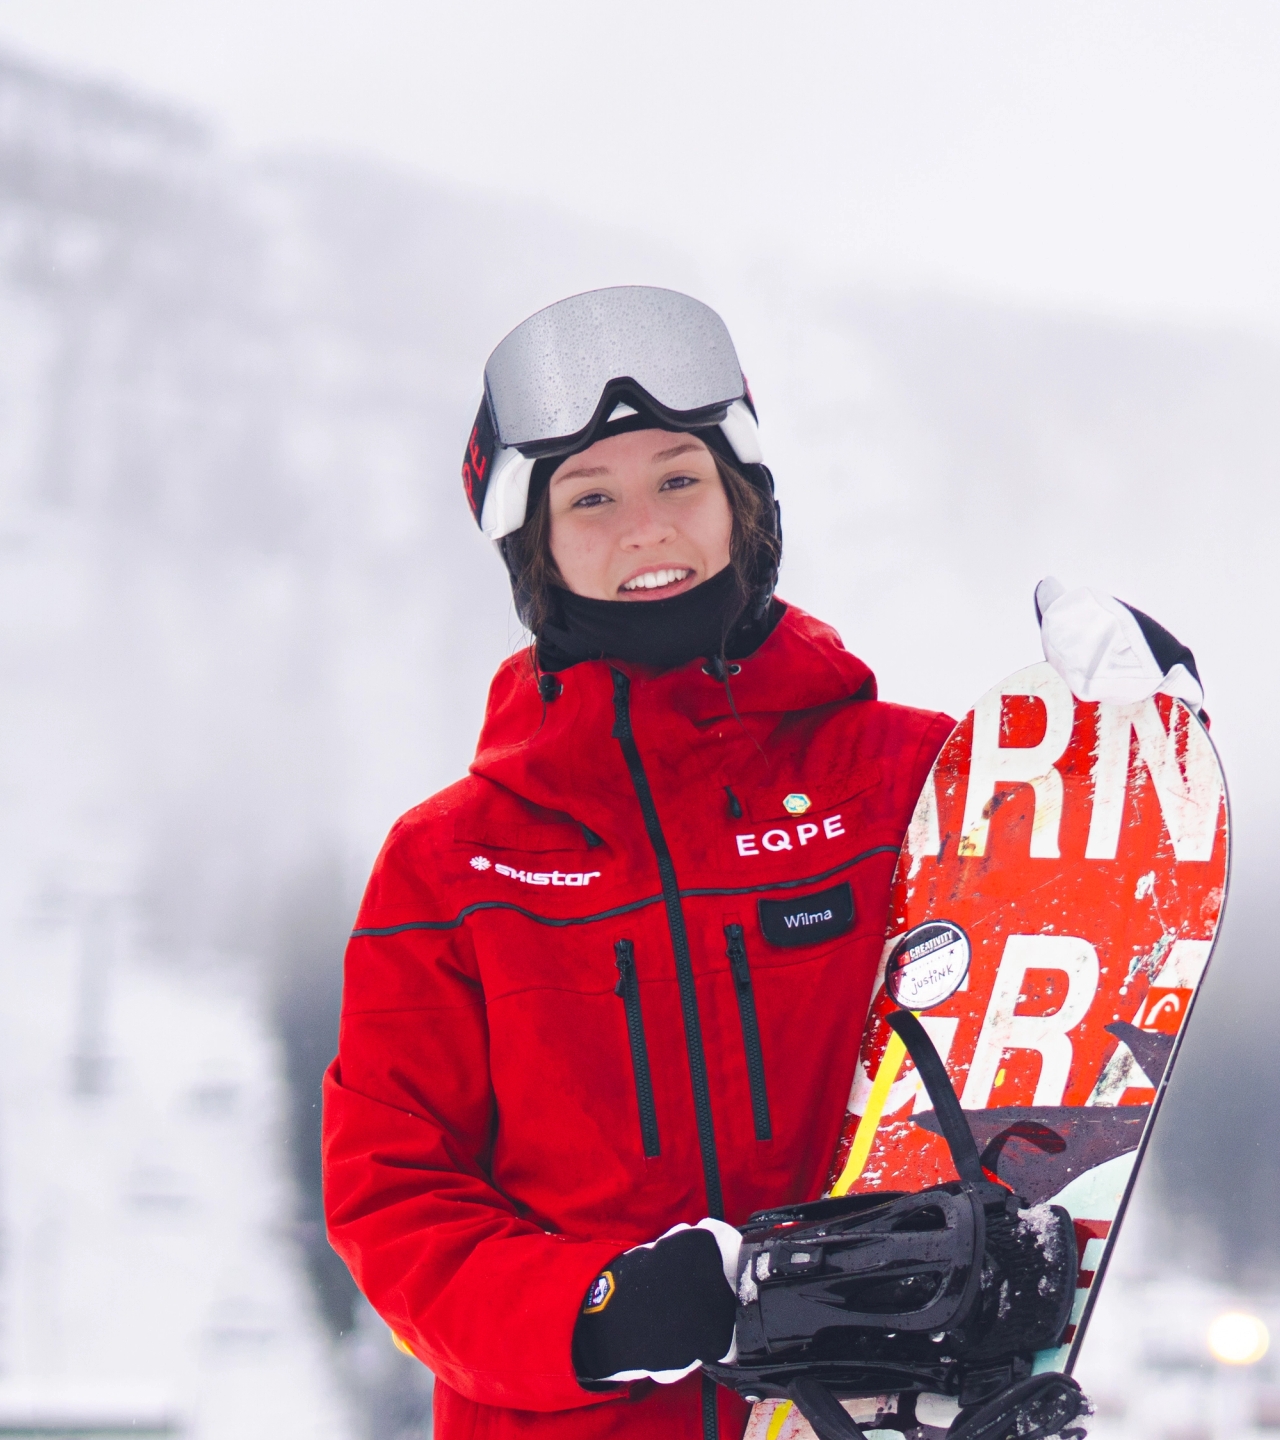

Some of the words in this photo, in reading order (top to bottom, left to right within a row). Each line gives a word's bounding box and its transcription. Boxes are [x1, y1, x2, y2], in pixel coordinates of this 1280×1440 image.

[736, 814, 846, 857] EQPE
[495, 863, 601, 886] skistar
[783, 909, 833, 929] Wilma
[909, 930, 954, 958] CREATIVITY
